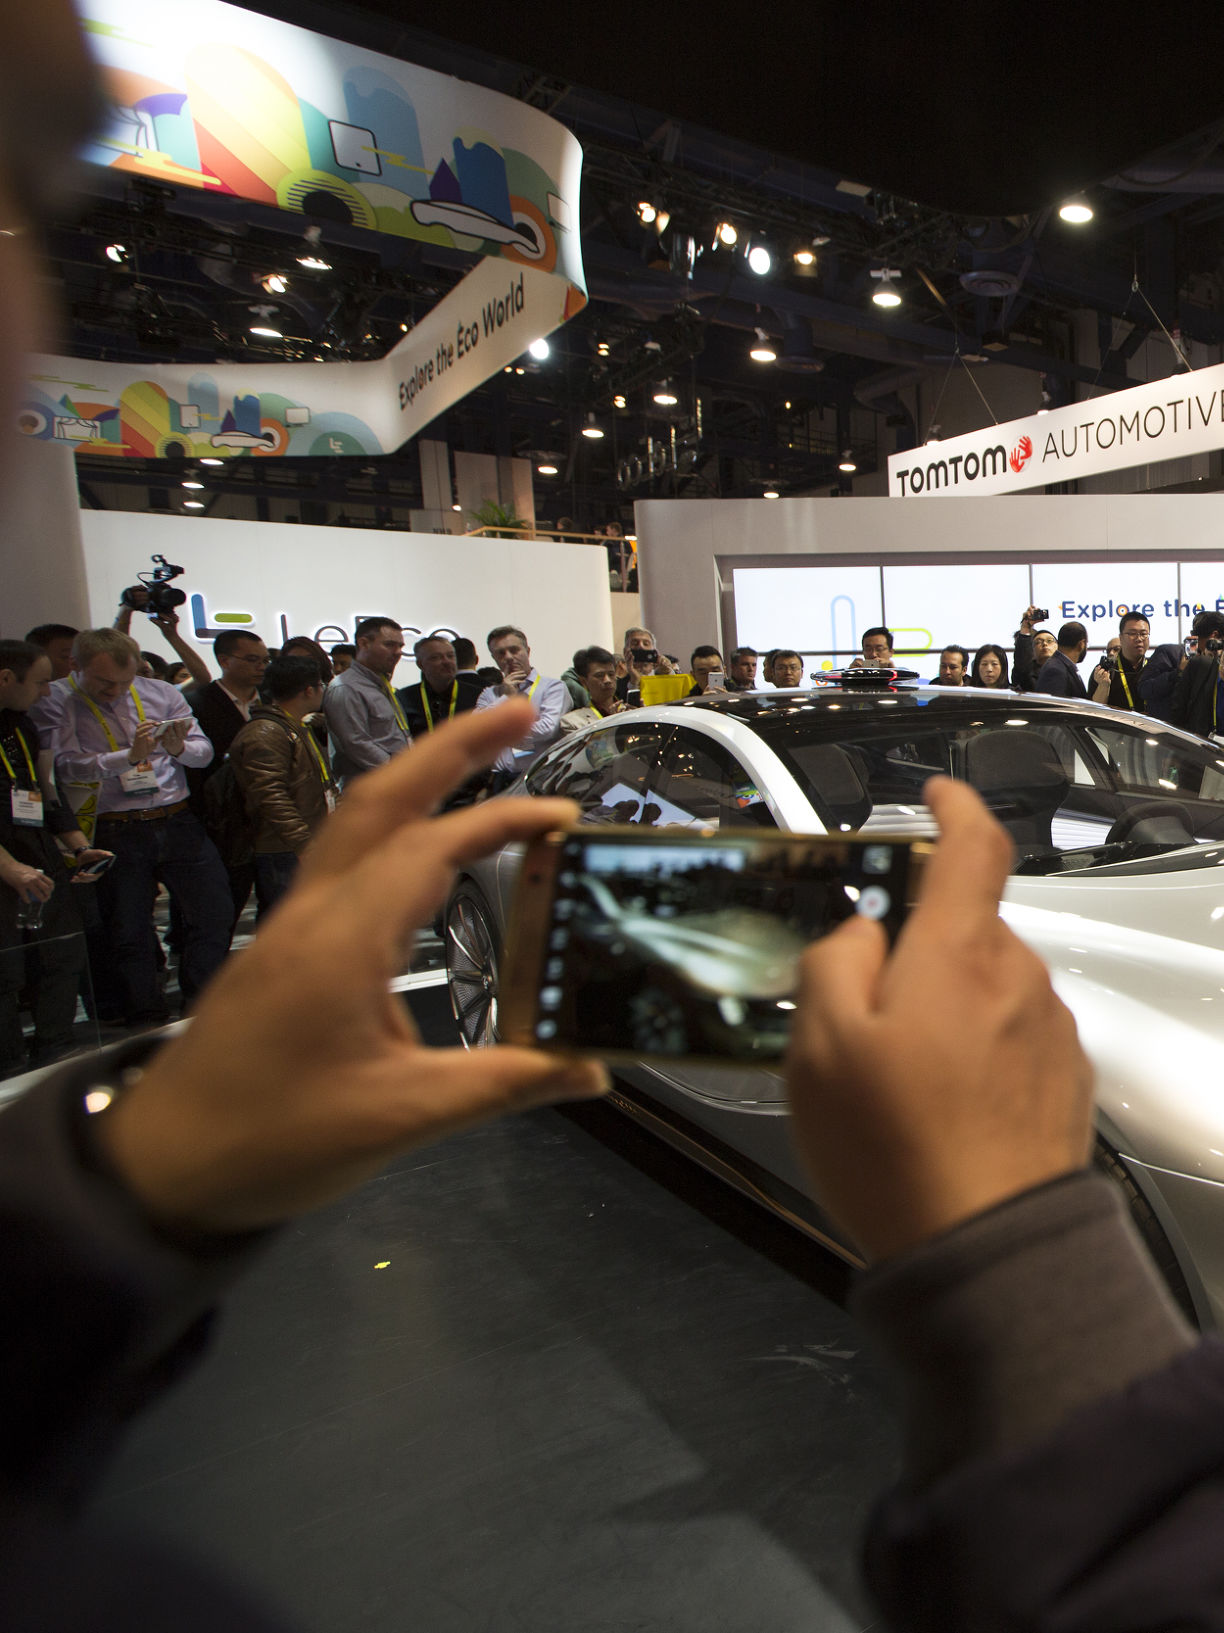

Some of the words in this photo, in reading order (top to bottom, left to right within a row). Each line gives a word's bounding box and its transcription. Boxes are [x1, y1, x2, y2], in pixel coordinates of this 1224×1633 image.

[399, 359, 434, 411] Explore
[436, 342, 454, 376] the
[482, 271, 525, 338] World
[1061, 599, 1155, 622] Explore
[1163, 598, 1206, 617] the
